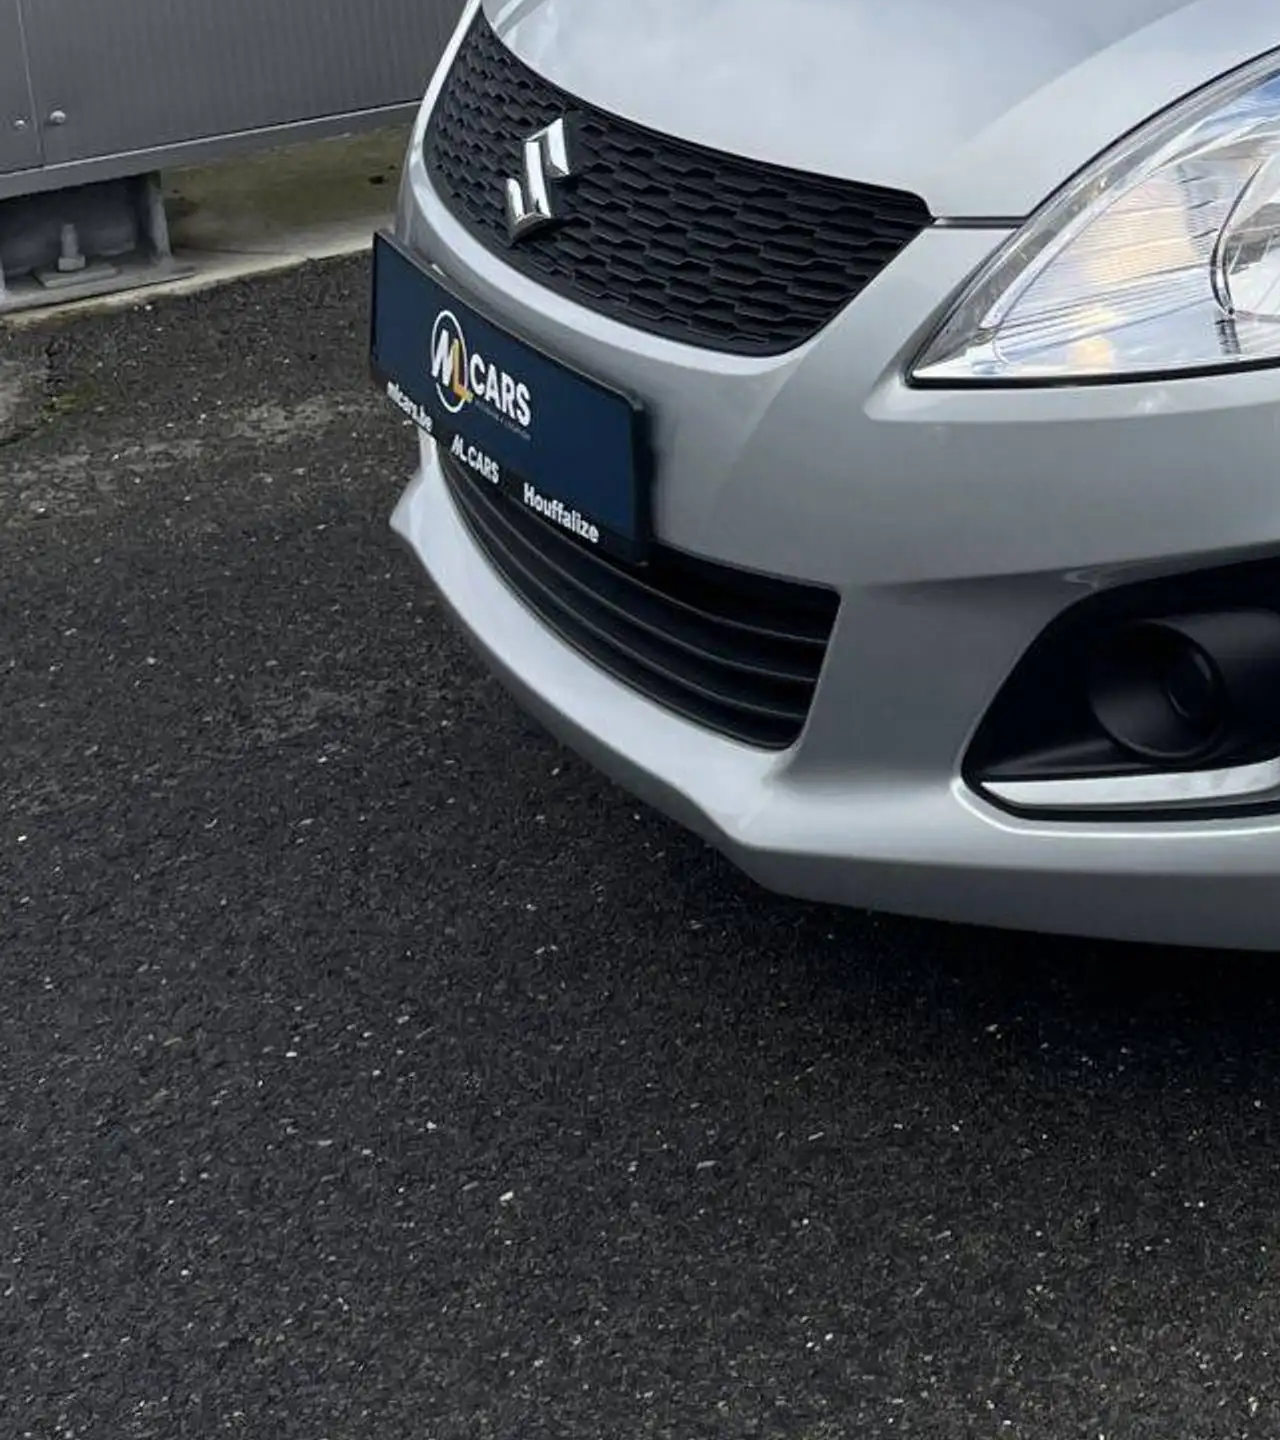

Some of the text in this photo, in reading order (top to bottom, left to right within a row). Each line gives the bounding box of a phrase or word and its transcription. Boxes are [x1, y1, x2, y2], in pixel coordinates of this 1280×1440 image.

[431, 328, 474, 404] ML
[470, 353, 532, 427] CARS
[523, 481, 600, 544] Houffalize
